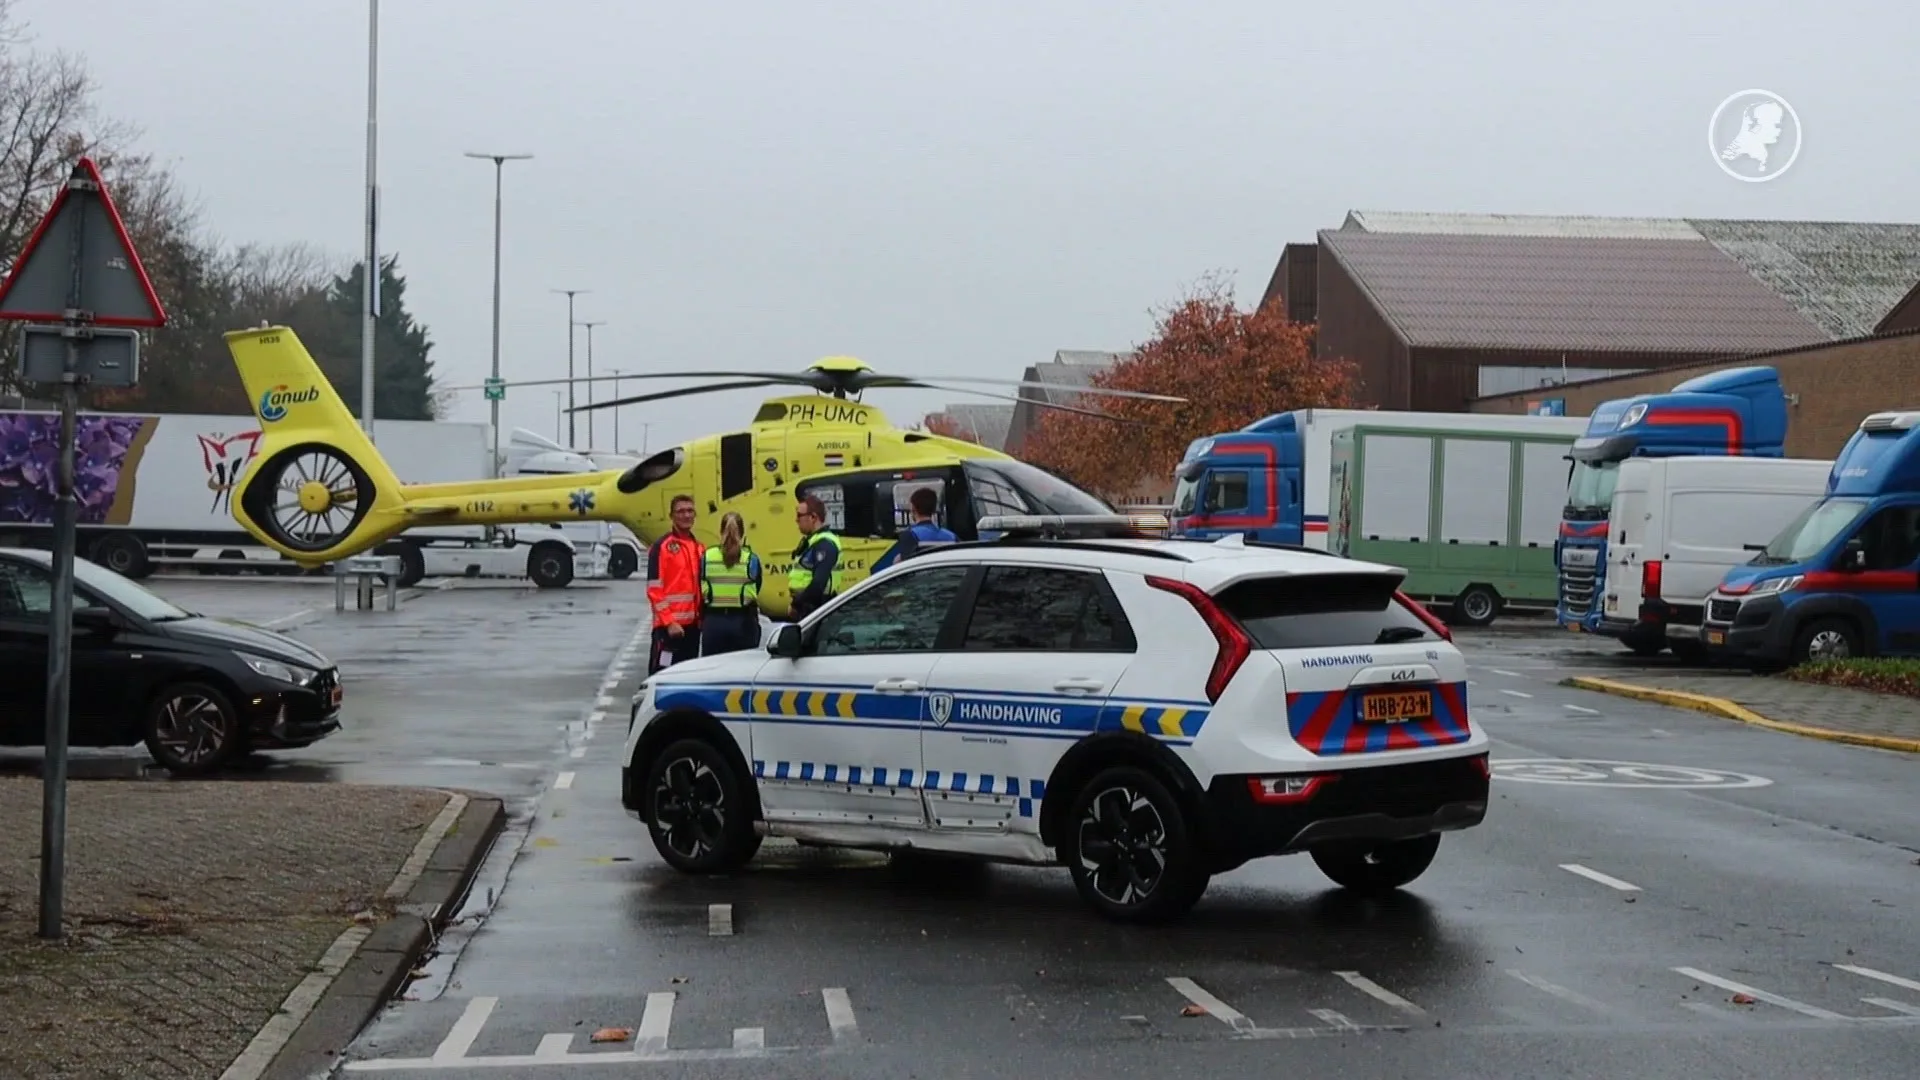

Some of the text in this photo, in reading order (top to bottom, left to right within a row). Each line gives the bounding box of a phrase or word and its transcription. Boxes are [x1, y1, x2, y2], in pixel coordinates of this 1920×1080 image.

[271, 385, 320, 405] anwb
[789, 403, 869, 426] PH-UMC
[816, 441, 851, 450] AIRBUS
[474, 500, 495, 513] 112
[1301, 653, 1374, 669] HANDHAVING
[960, 702, 1062, 725] HANDHAVING
[1367, 694, 1429, 719] HBB-23-N
